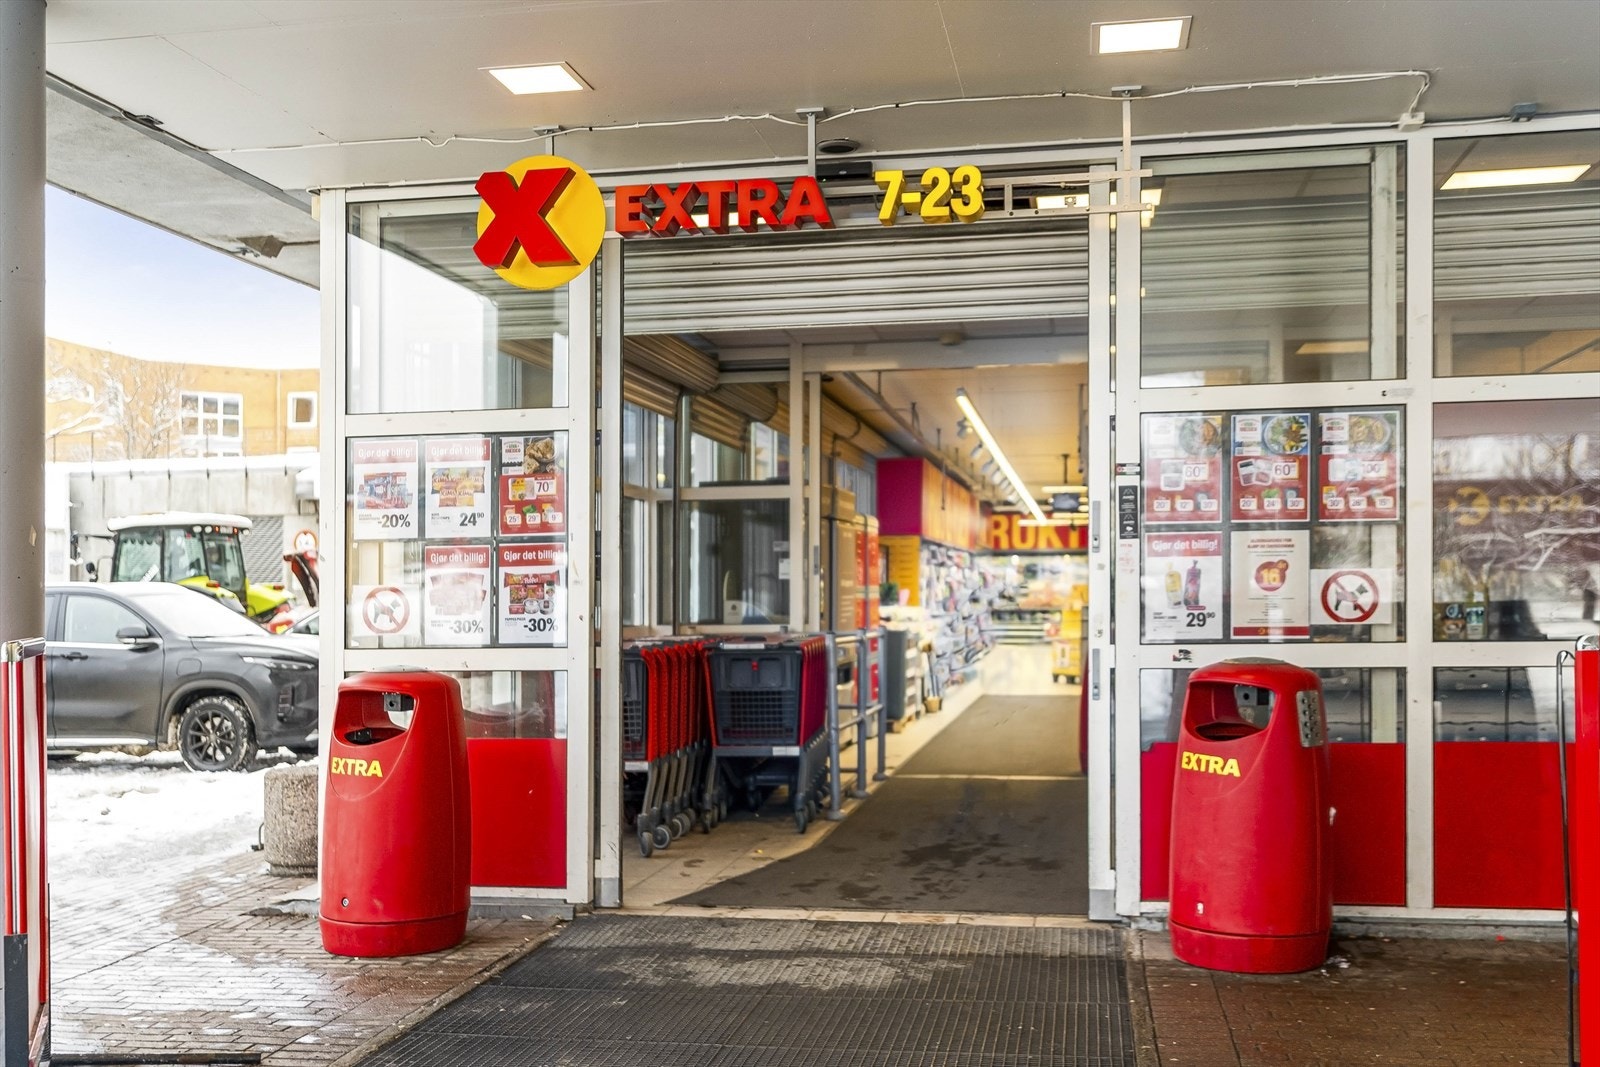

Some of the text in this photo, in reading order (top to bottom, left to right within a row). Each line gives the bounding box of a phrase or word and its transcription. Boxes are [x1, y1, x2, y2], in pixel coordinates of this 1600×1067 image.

[875, 164, 985, 226] 7-23
[615, 176, 835, 236] EXTRA
[1274, 464, 1291, 476] 60
[536, 481, 549, 493] 70
[378, 513, 411, 528] -20%
[1173, 540, 1190, 550] det
[430, 552, 486, 565] Gjør det billig!
[504, 551, 521, 563] Gjør
[522, 550, 537, 560] det
[1262, 568, 1281, 585] 16
[449, 620, 484, 634] -30%
[524, 618, 558, 632] -30%
[331, 756, 383, 778] EXTRA
[1182, 751, 1241, 778] EXTRA
